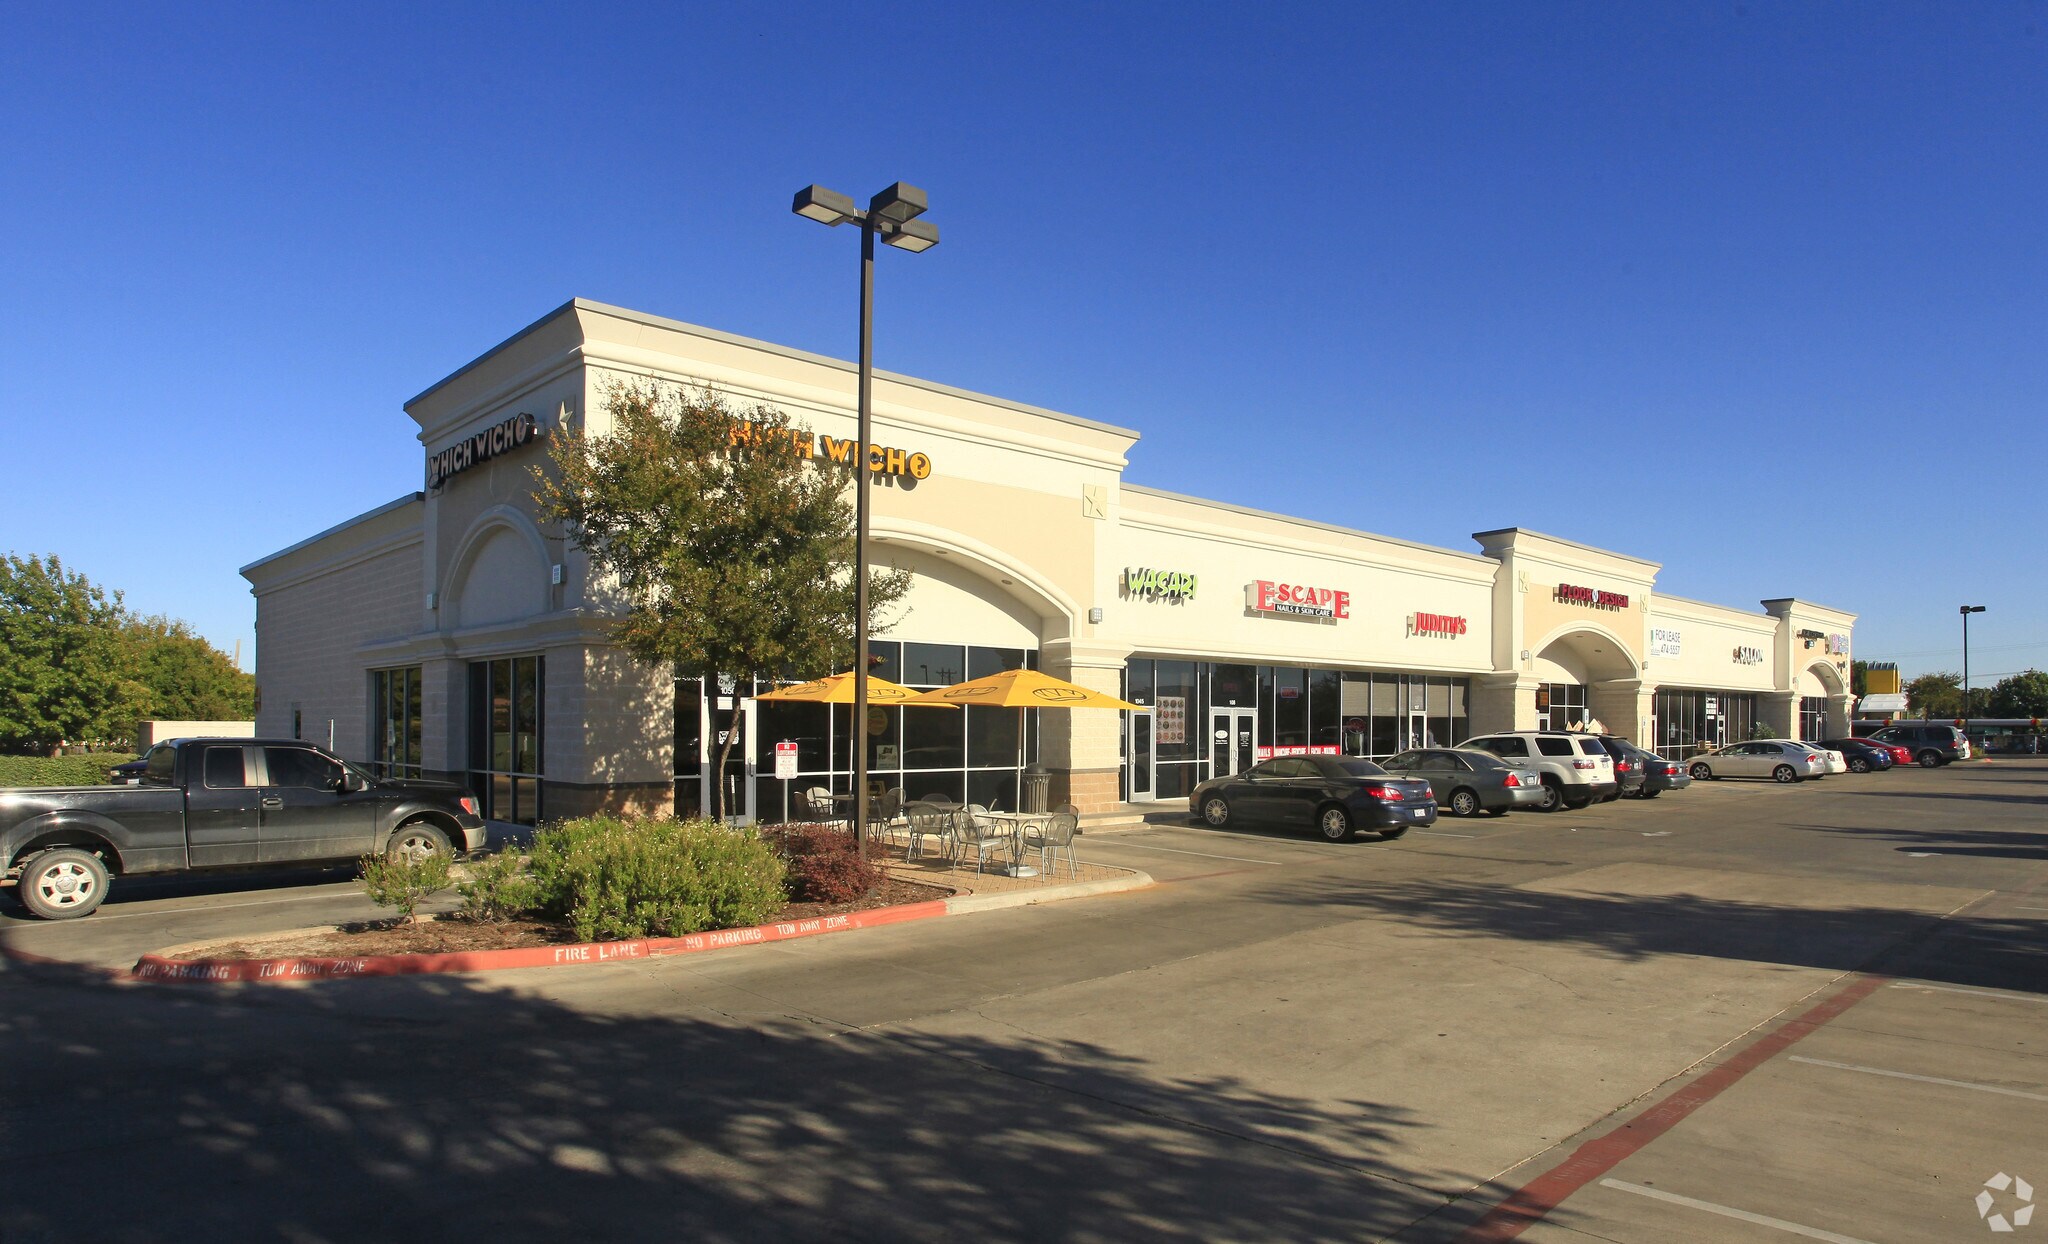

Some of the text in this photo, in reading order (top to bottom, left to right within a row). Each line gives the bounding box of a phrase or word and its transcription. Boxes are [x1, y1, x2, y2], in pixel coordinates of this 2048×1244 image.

[429, 438, 472, 482] WHICH
[1126, 567, 1197, 600] WASABI
[1560, 583, 1593, 602] FLOOR
[1598, 590, 1629, 608] DESIGN
[1256, 579, 1350, 619] ESCAPE
[1276, 604, 1294, 613] NAILS
[1301, 606, 1315, 615] SKIN
[1315, 608, 1331, 617] CARE
[1414, 611, 1467, 636] JUDITH'S
[1655, 629, 1681, 643] FOR LEASE
[686, 915, 850, 949] NO PARKING TOW AWAY ZONE
[555, 943, 639, 962] FIRE LANE
[260, 962, 287, 978] TOW
[330, 959, 368, 974] ZONE
